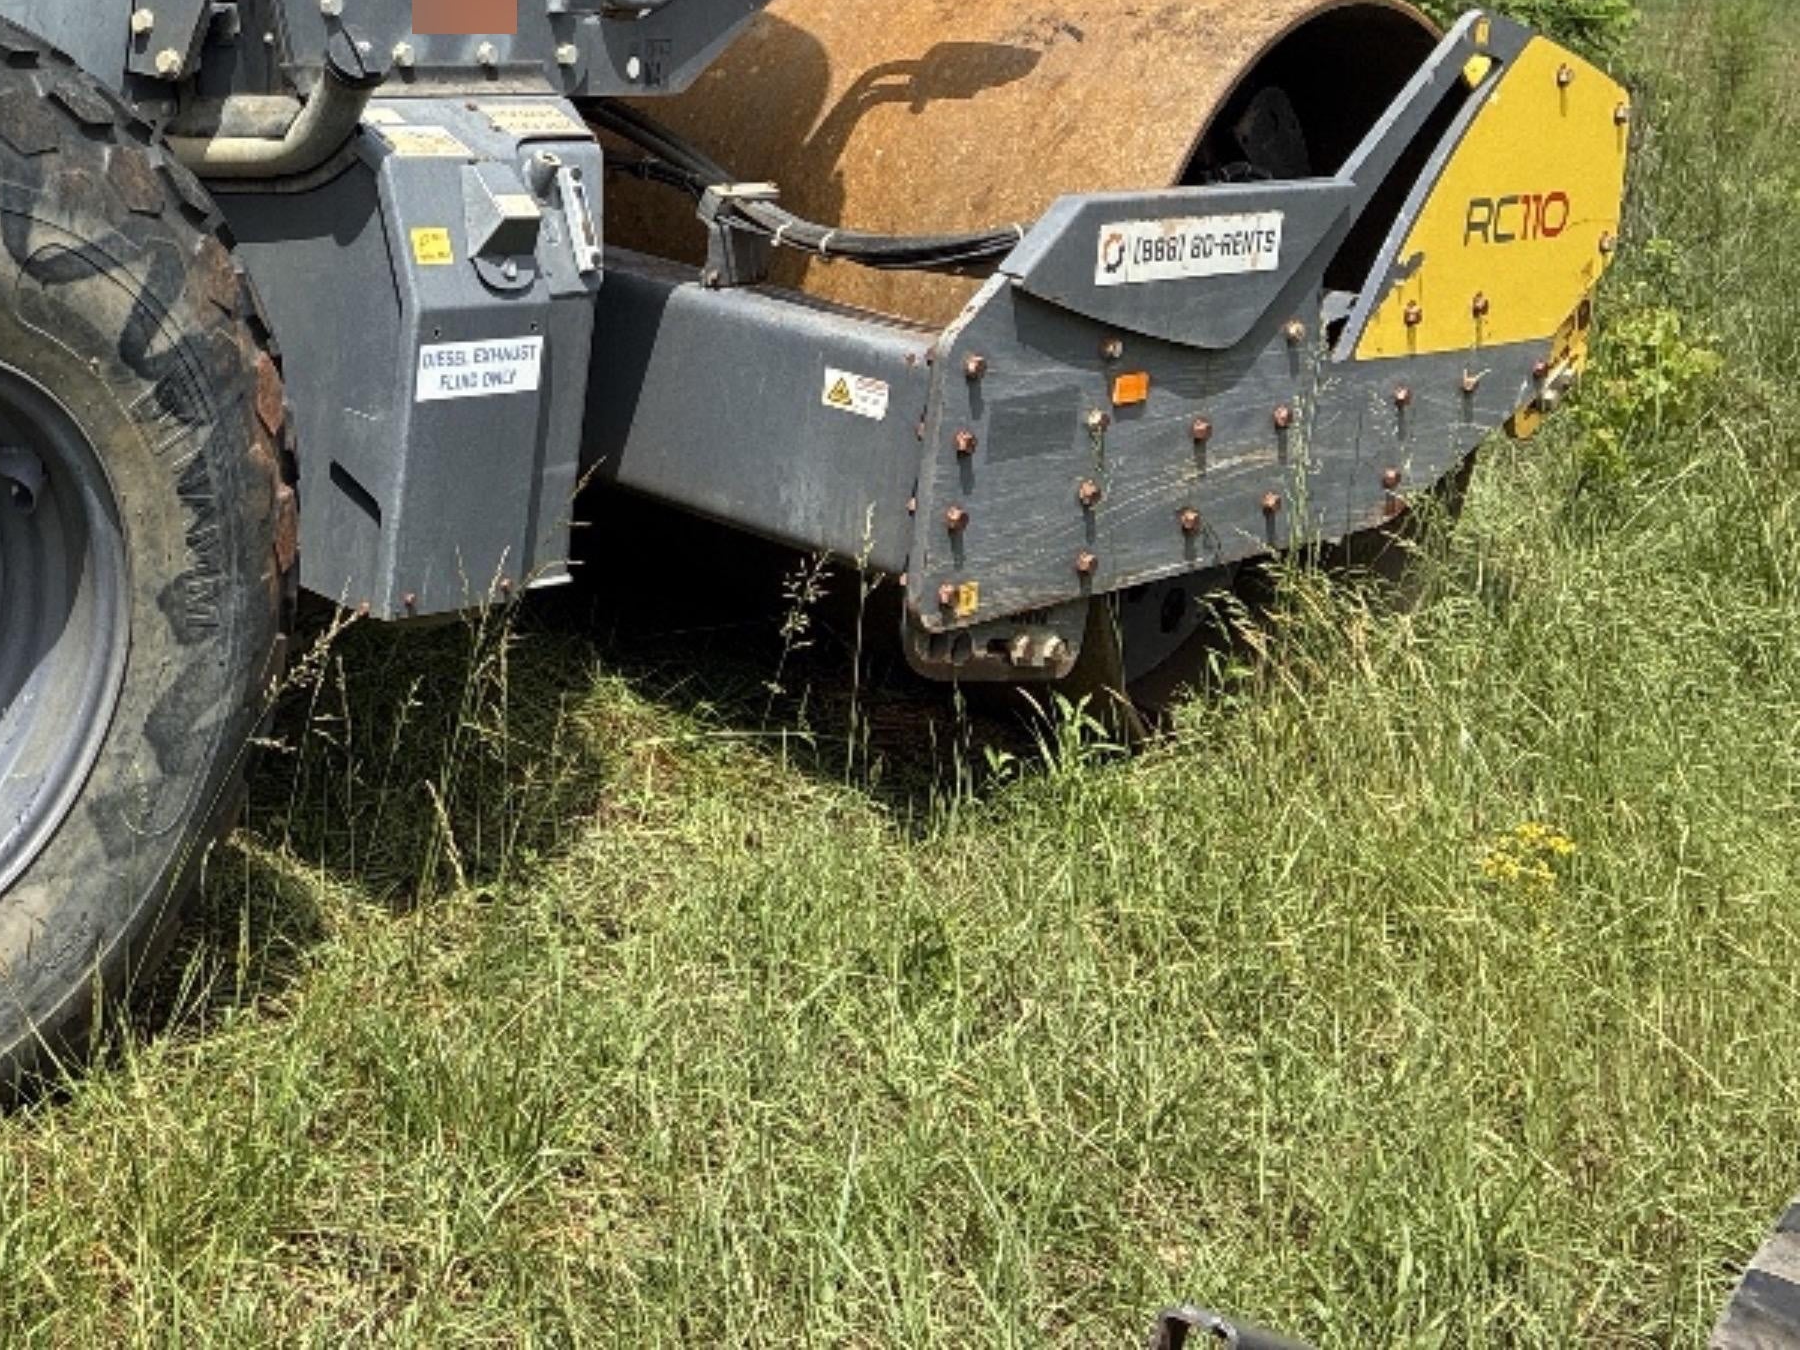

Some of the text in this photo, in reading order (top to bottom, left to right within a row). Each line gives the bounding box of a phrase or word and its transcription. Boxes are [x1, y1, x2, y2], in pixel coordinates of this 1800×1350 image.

[1464, 191, 1569, 247] RC110
[422, 344, 536, 370] DIESEL EXHAUST
[440, 369, 516, 390] FLUID ONLY
